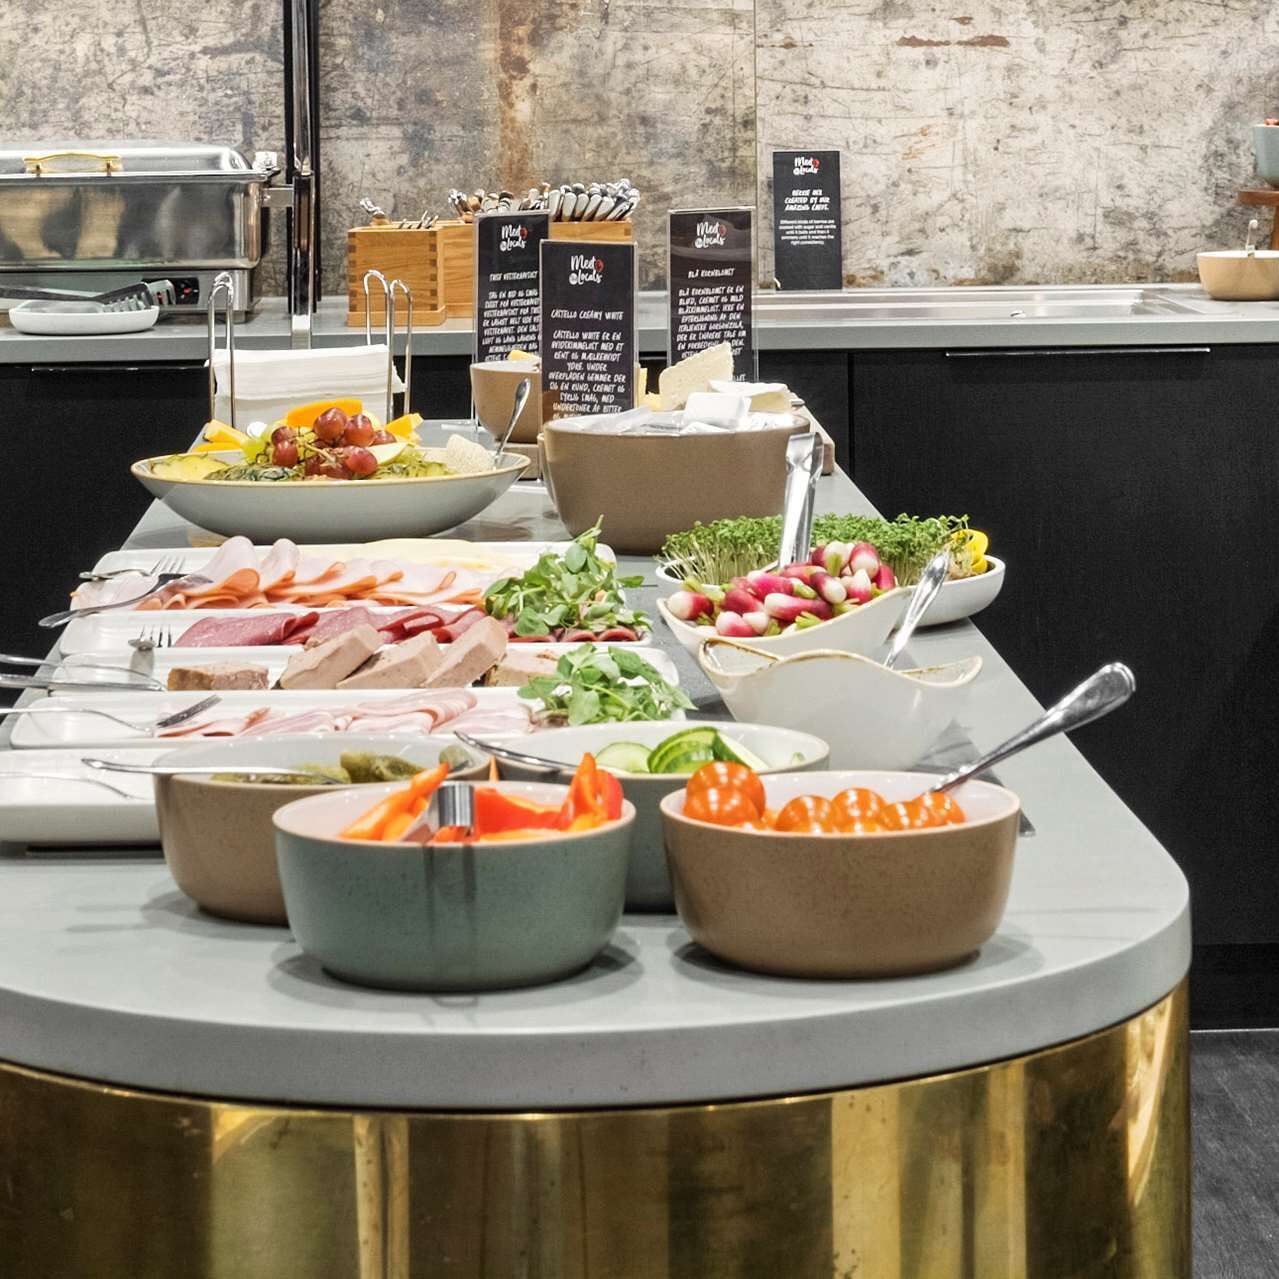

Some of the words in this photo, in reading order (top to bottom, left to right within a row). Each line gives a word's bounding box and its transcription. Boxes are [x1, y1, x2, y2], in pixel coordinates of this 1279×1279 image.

[696, 221, 719, 236] Meet
[570, 254, 596, 271] Meet
[550, 308, 577, 319] CASTELLO
[579, 310, 603, 321] CREAMY
[604, 311, 624, 321] WHITE
[553, 329, 579, 339] CASTELLO
[581, 331, 601, 341] WHITE
[602, 331, 610, 341] ER
[611, 331, 622, 341] EN
[600, 342, 614, 351] MED
[615, 342, 625, 352] ET
[553, 350, 571, 360] RENT
[571, 351, 579, 360] OG
[586, 362, 608, 372] UNDER
[613, 374, 626, 383] DER
[560, 382, 570, 391] EN
[617, 384, 626, 393] OG
[601, 394, 615, 404] MED
[591, 403, 600, 413] AF
